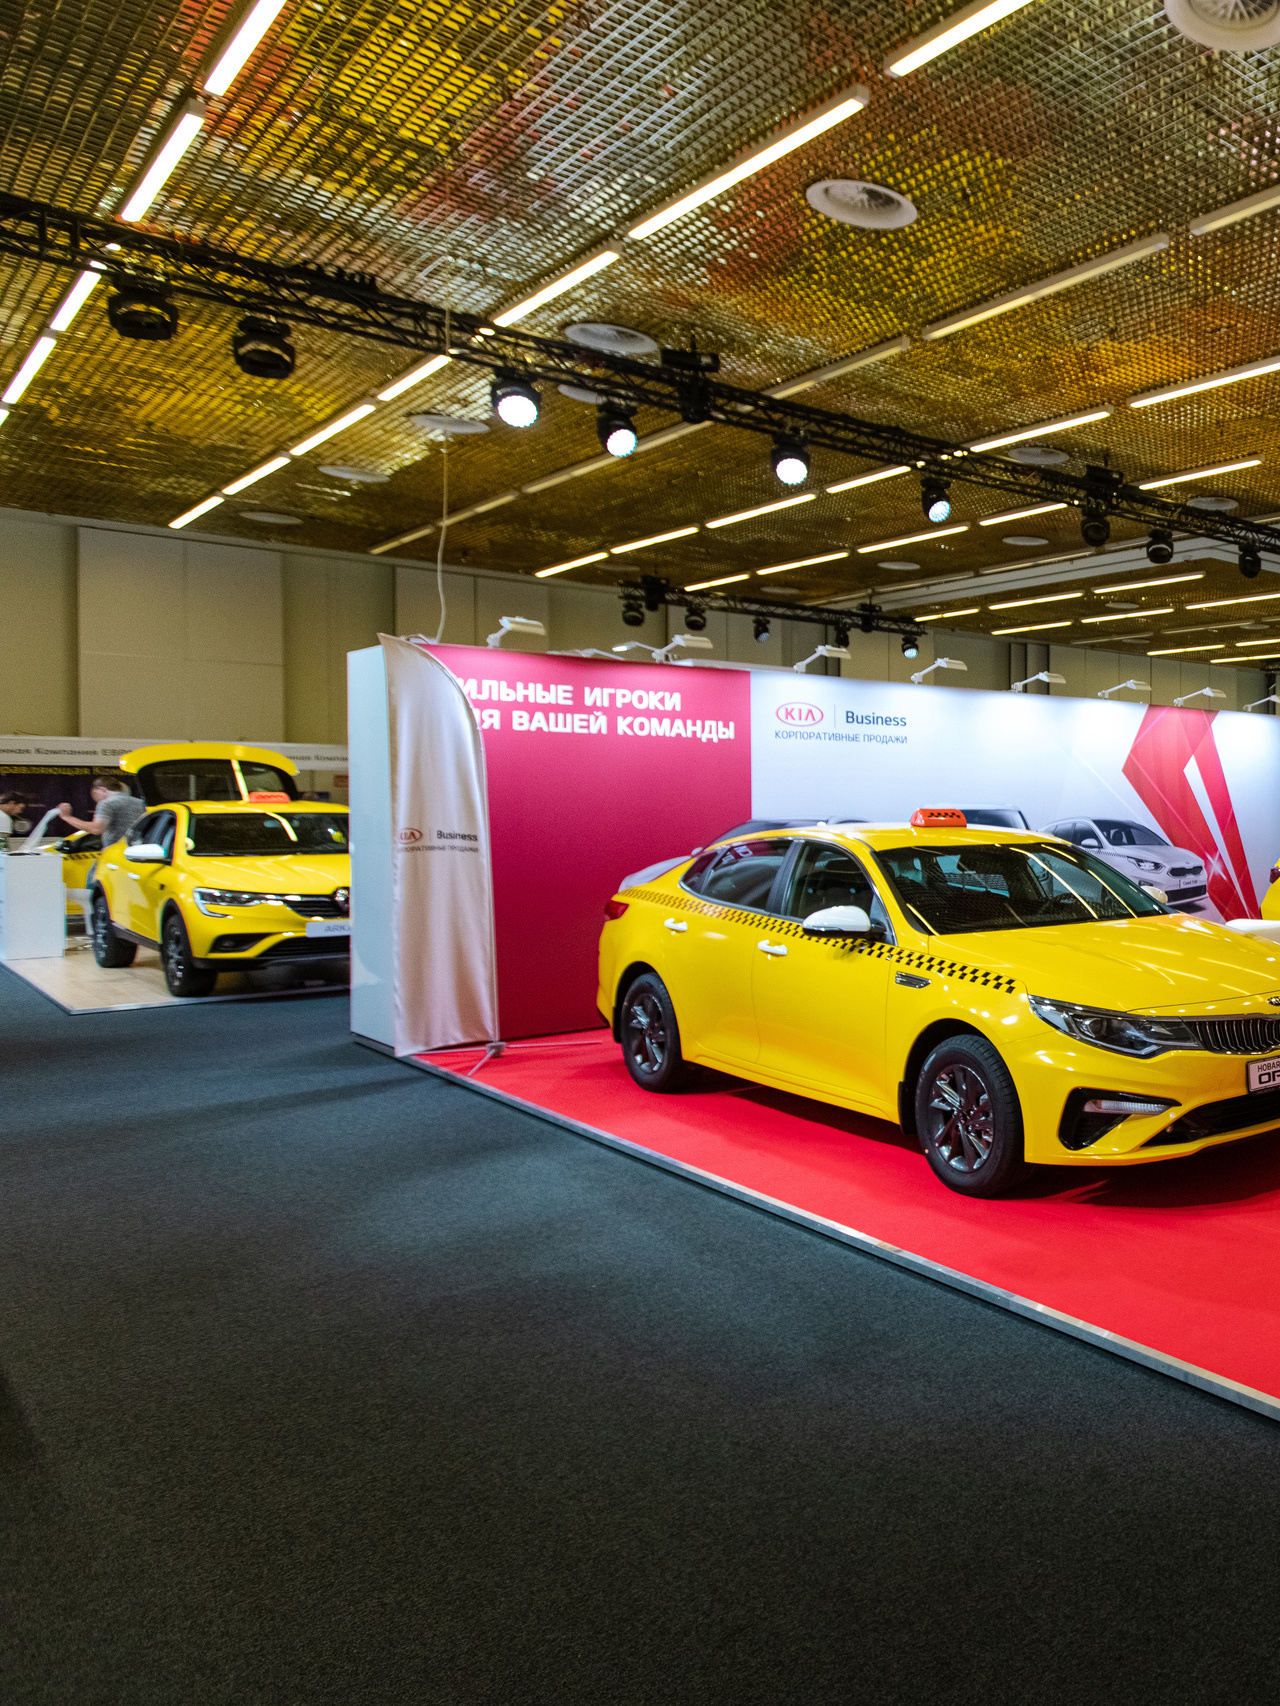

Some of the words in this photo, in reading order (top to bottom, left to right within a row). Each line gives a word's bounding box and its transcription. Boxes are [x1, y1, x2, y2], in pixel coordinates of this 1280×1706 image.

[456, 677, 574, 705] ИЛЬНЫЕ
[583, 686, 682, 711] ИГРОКИ
[784, 707, 816, 722] KIA
[845, 709, 908, 727] Business
[511, 710, 608, 735] ВАШЕЙ
[616, 715, 736, 743] КОМАНДЫ
[774, 729, 861, 743] КОРПОРАТИВНЫЕ
[862, 733, 908, 745] ПРОДАЖИ
[436, 830, 478, 842] Business
[1257, 1061, 1280, 1073] НОВАЯ
